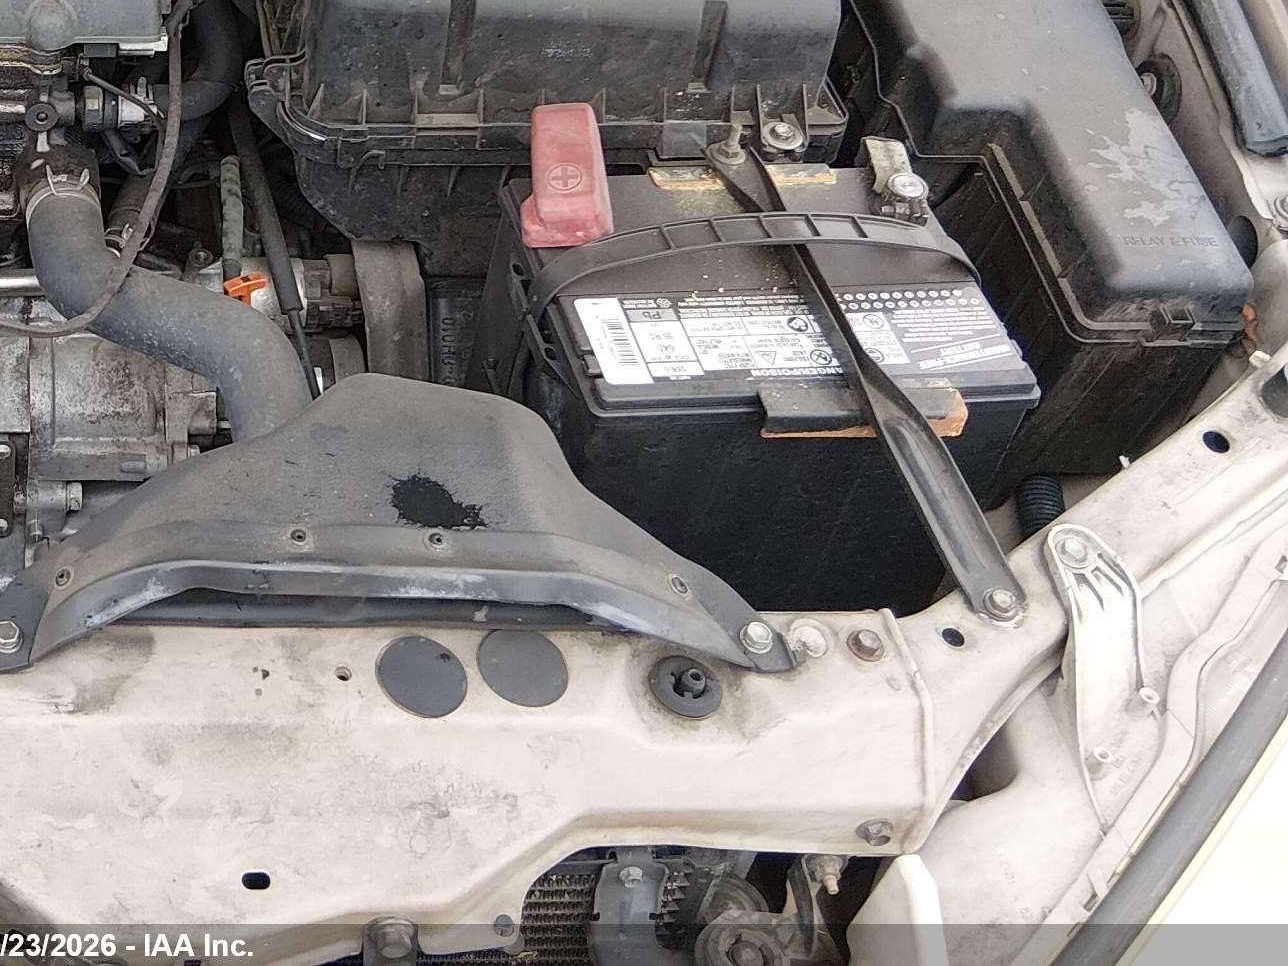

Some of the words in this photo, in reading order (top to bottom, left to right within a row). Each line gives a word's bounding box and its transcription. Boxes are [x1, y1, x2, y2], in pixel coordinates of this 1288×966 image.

[1122, 234, 1165, 247] RELAY
[1182, 236, 1219, 247] FUSE
[642, 311, 662, 320] Pb
